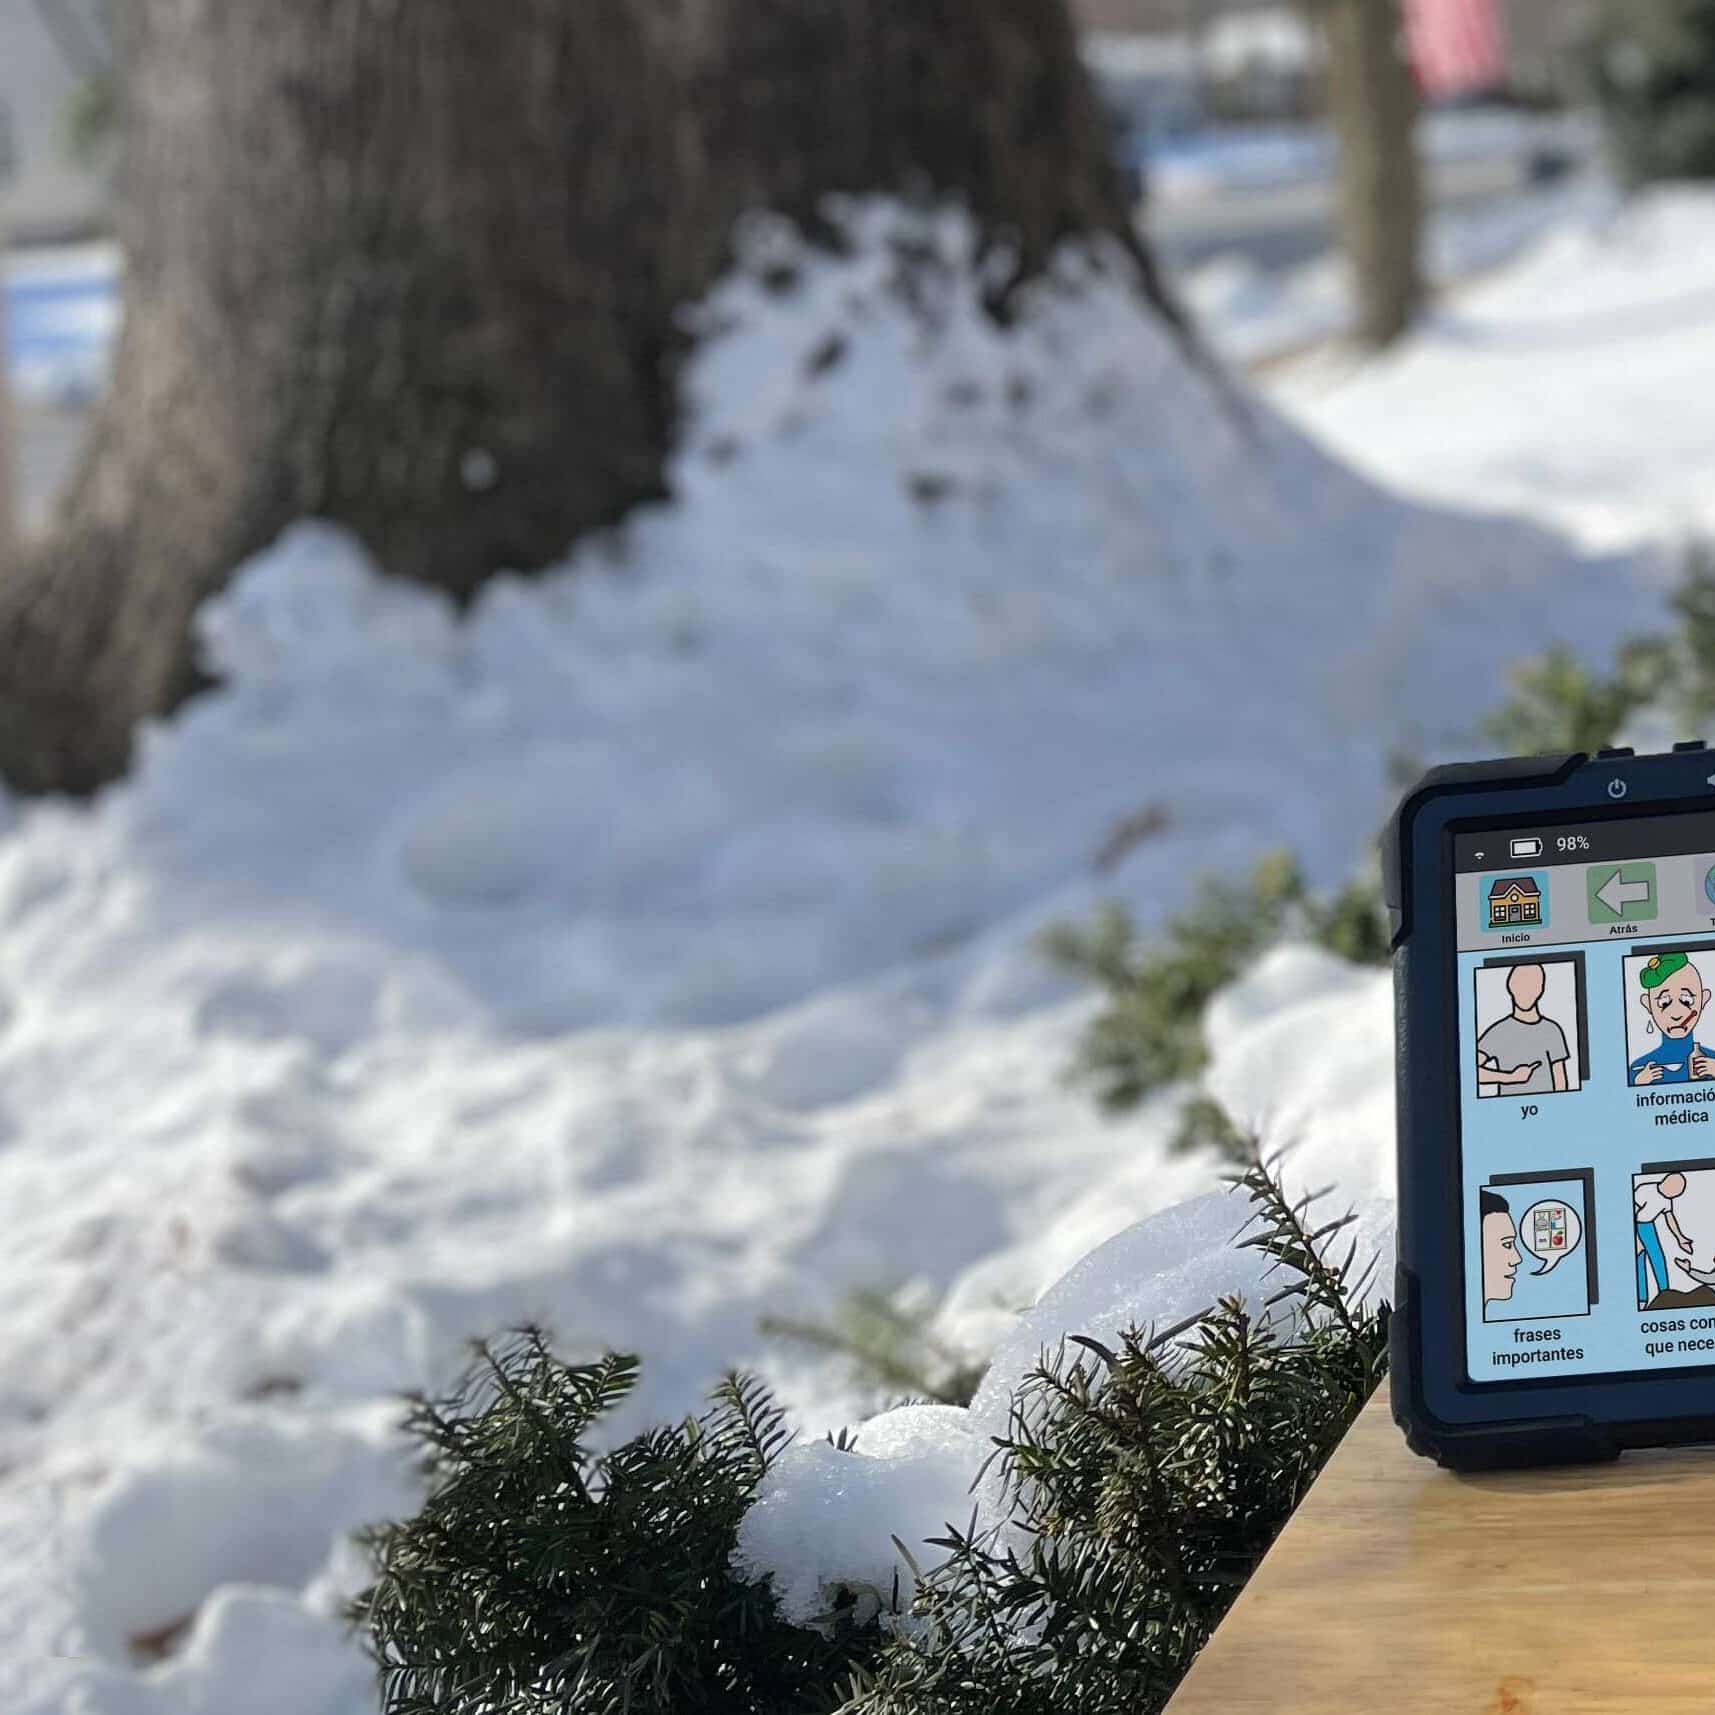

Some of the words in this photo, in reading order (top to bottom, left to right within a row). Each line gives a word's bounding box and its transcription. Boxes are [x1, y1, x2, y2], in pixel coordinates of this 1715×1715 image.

[1556, 835, 1590, 852] 98%
[1501, 932, 1531, 944] Inicio
[1609, 924, 1638, 935] Atrás
[1520, 1104, 1539, 1121] yo
[1654, 1109, 1709, 1126] médica
[1640, 1319, 1686, 1334] cosas
[1513, 1327, 1562, 1344] frases
[1492, 1347, 1584, 1368] importantes
[1645, 1341, 1674, 1358] que
